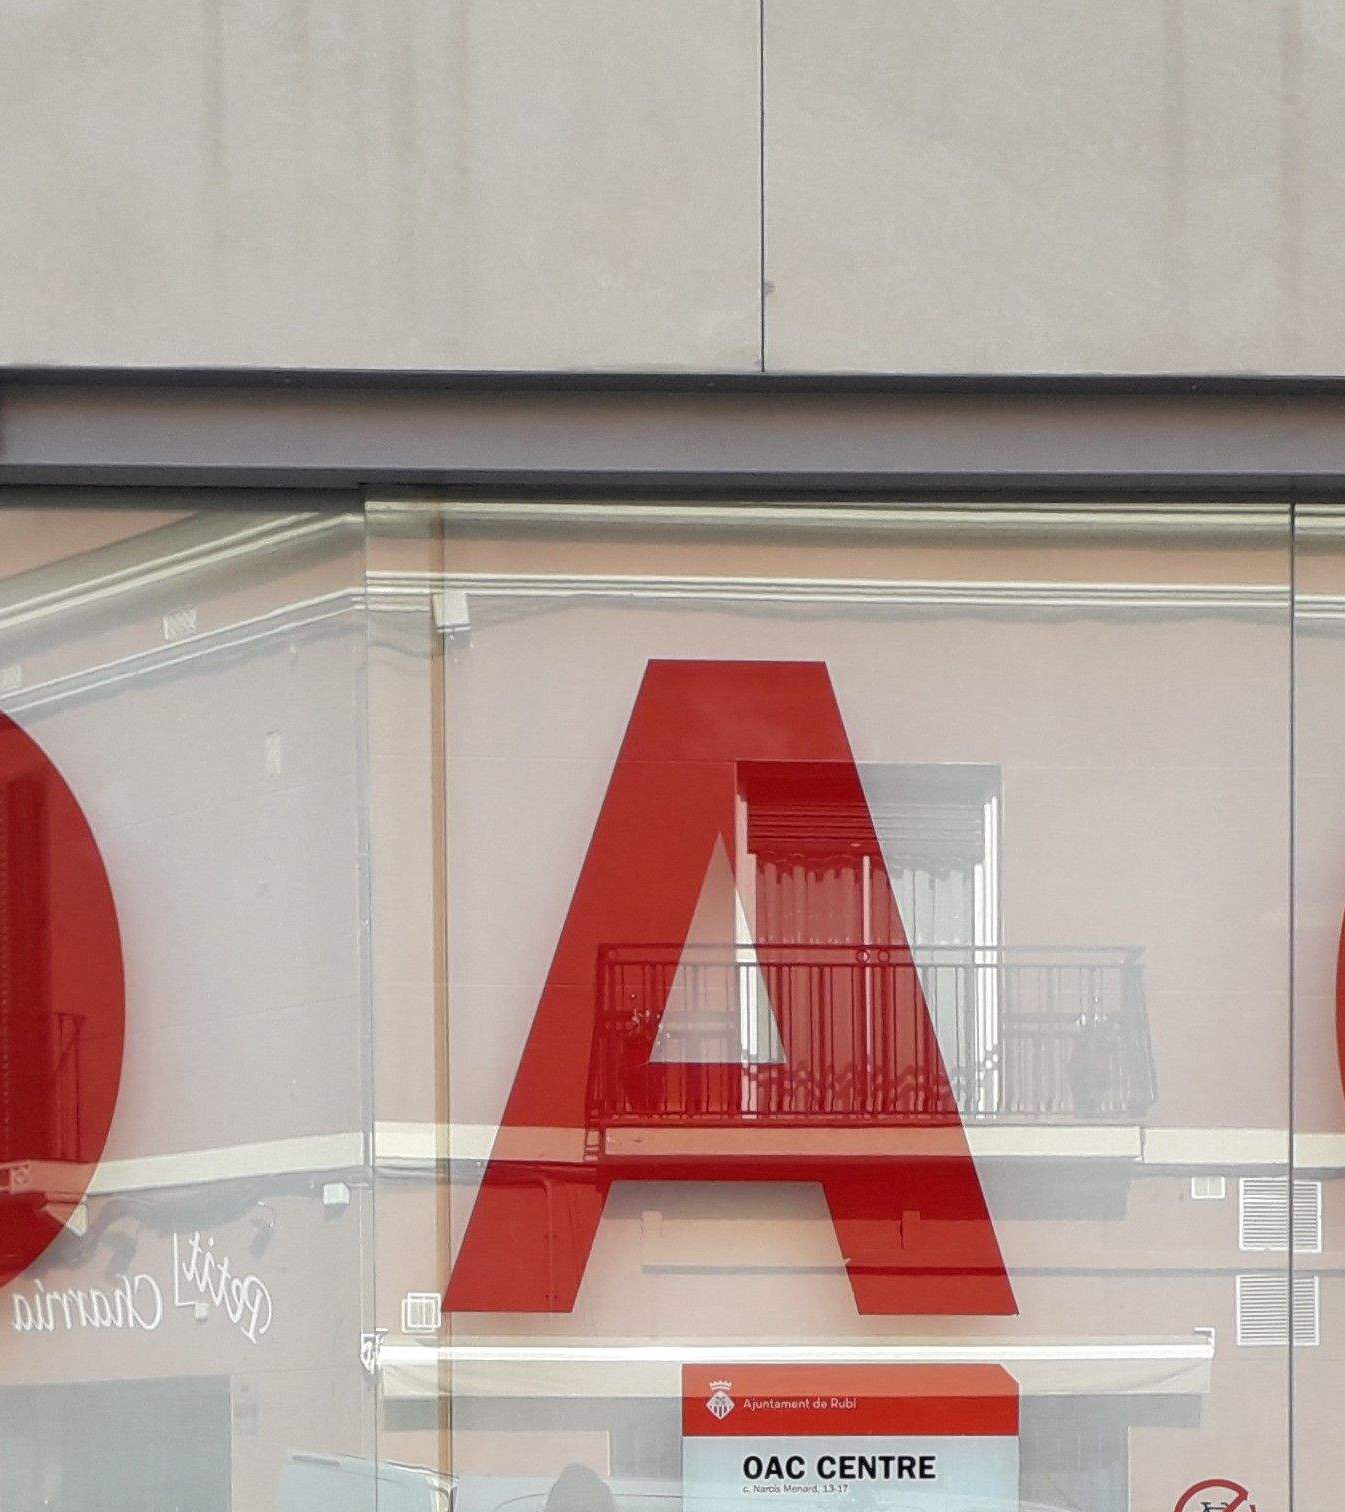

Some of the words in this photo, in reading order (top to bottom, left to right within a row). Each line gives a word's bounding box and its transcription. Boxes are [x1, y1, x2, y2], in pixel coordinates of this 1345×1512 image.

[743, 1398, 810, 1411] Ajuntament
[813, 1398, 827, 1409] de
[743, 1455, 805, 1480] OAC
[817, 1455, 936, 1480] CENTRE
